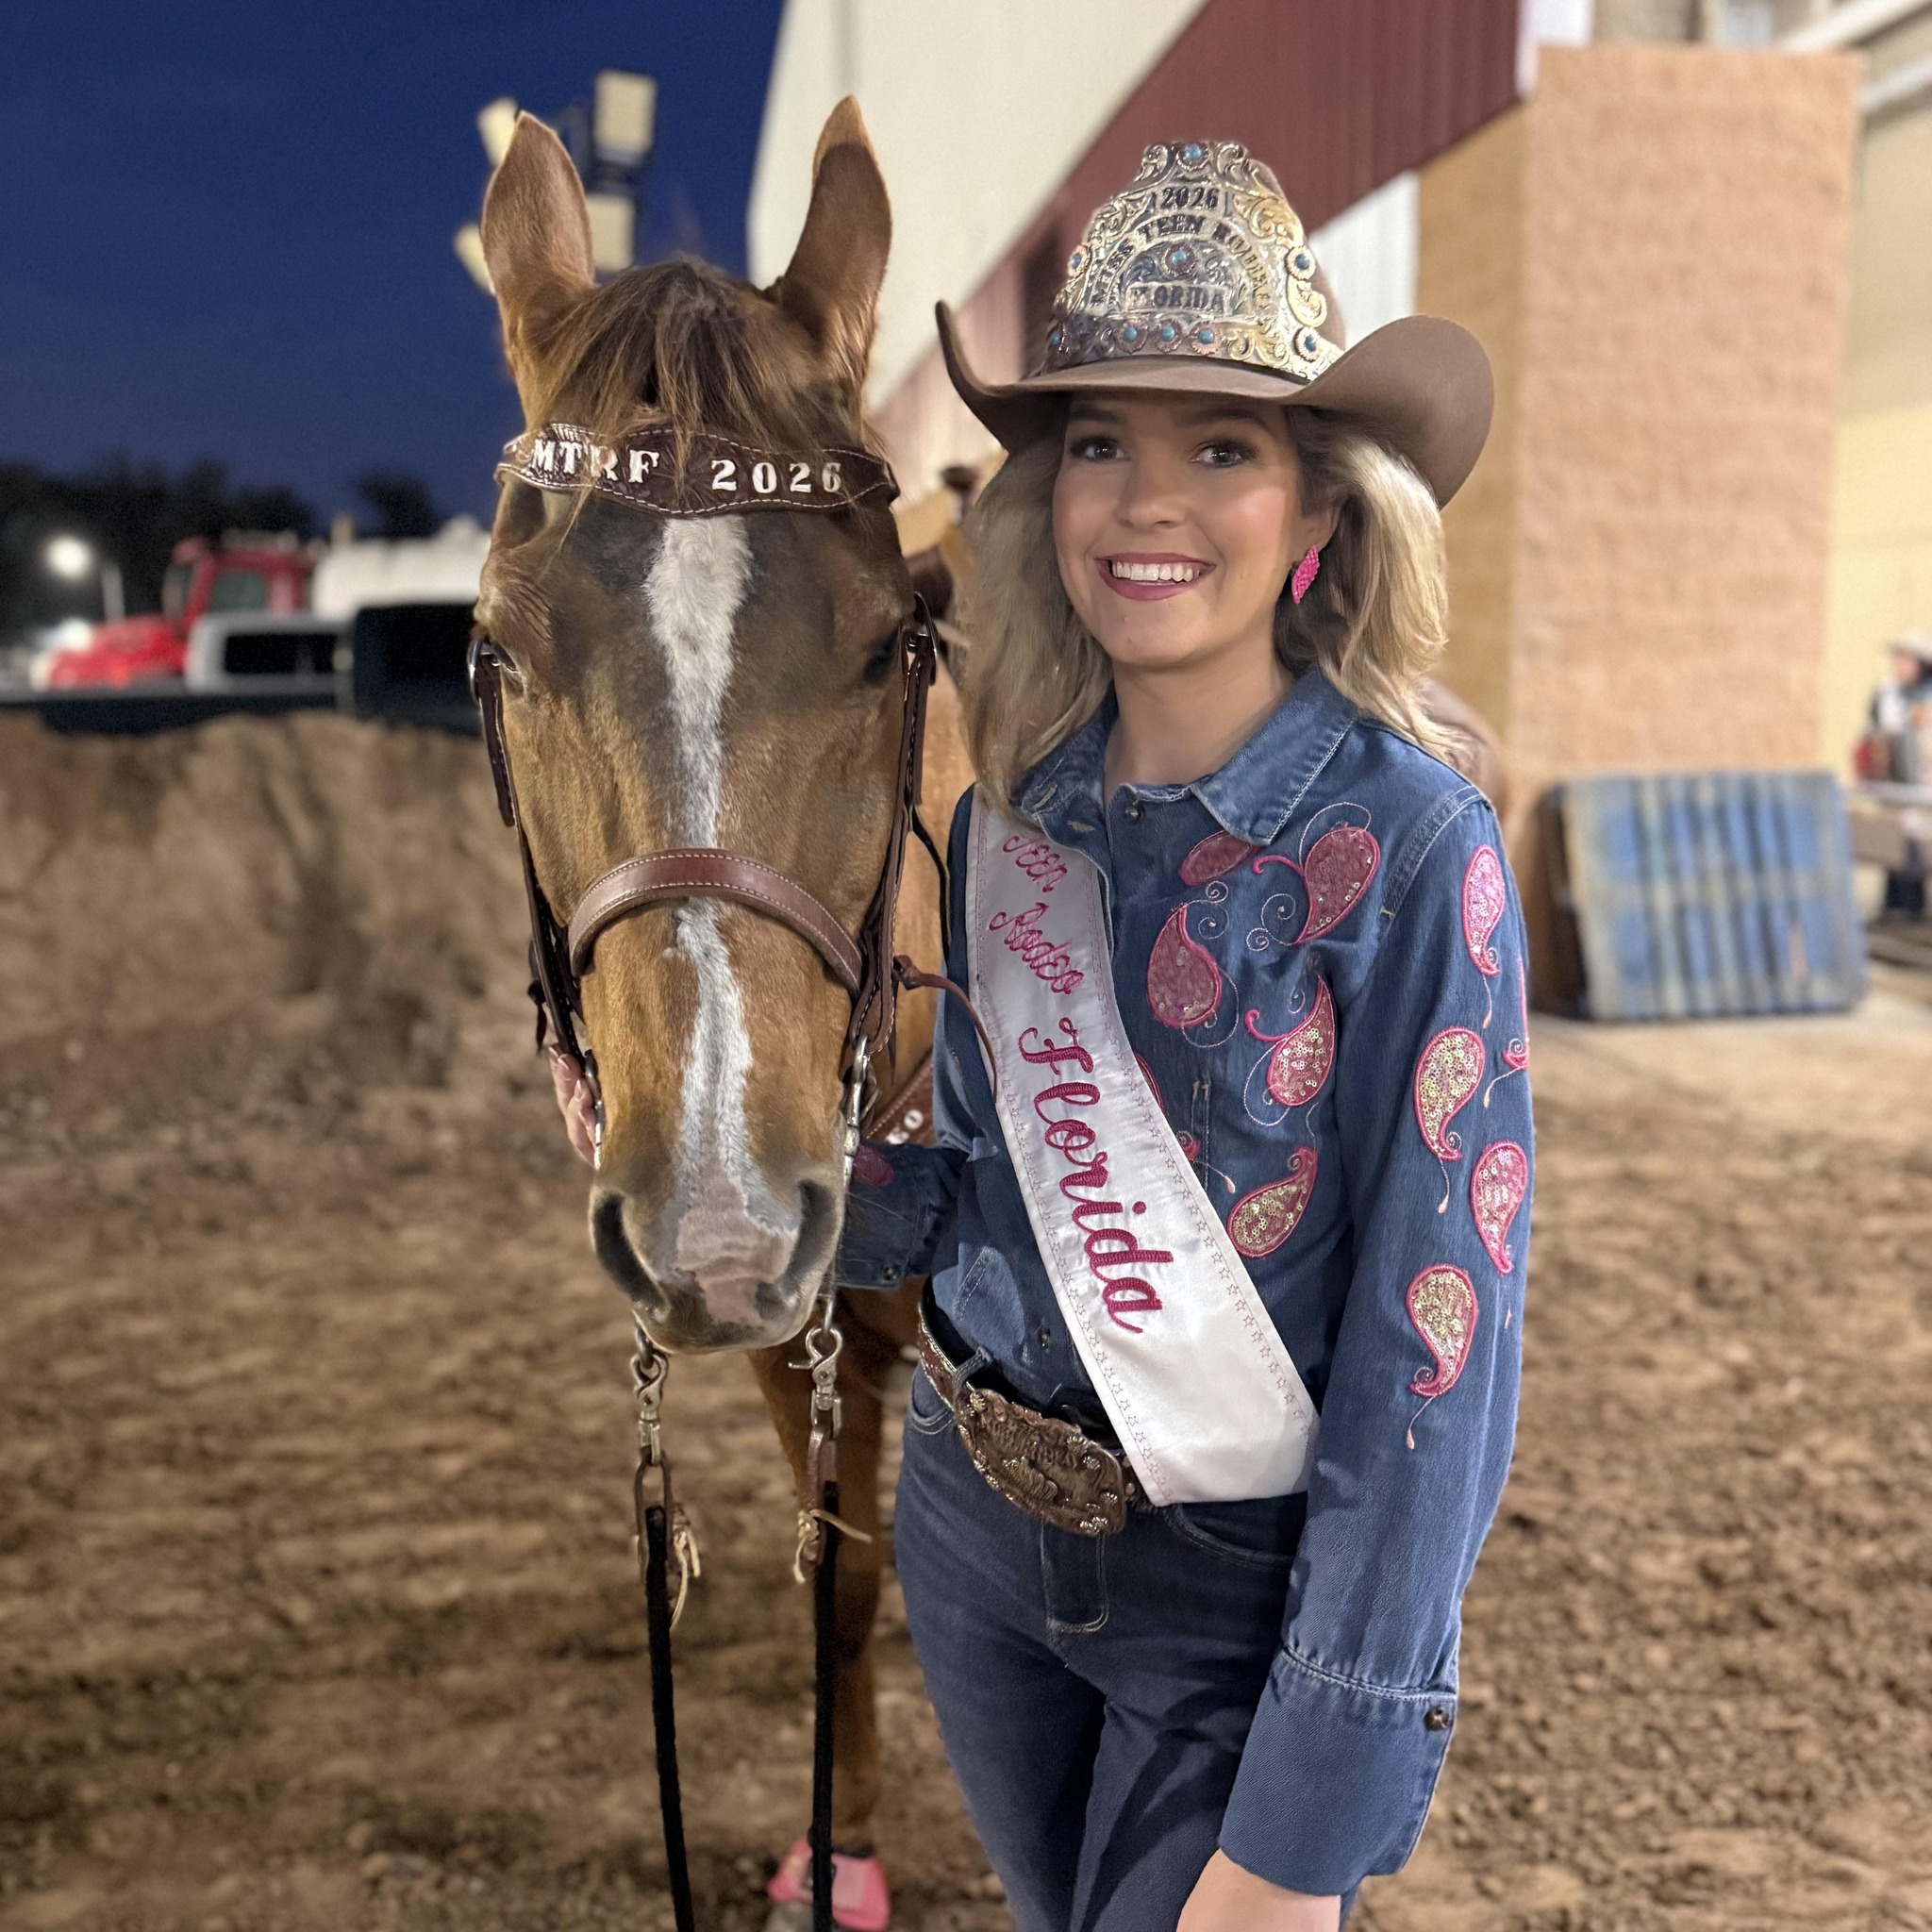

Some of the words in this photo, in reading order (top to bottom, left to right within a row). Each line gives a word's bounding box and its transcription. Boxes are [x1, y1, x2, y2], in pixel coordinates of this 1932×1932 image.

[1160, 187, 1219, 209] 2026
[1138, 214, 1207, 242] TEEN
[530, 439, 659, 483] MTRF
[710, 459, 841, 494] 2026
[989, 902, 1084, 995] Rodeo
[1018, 1018, 1174, 1334] Florida
